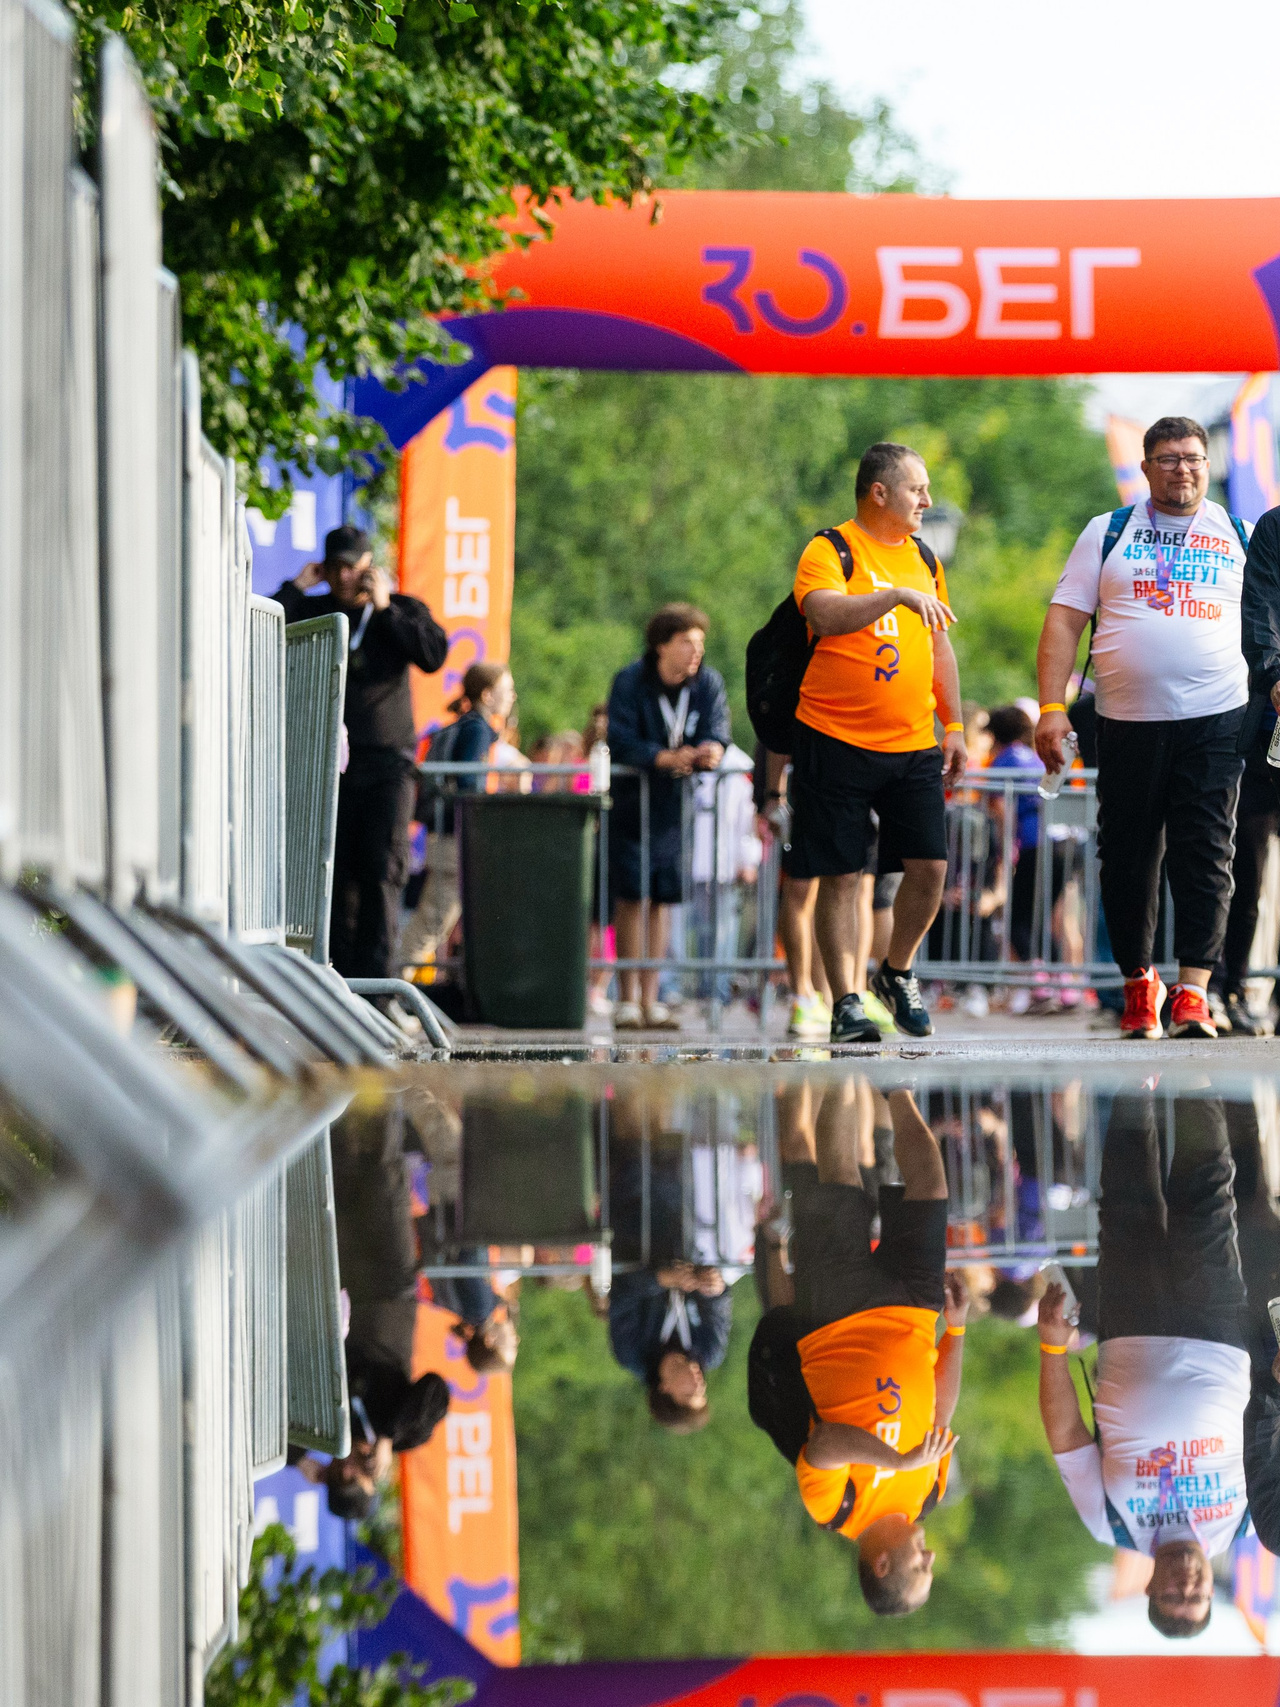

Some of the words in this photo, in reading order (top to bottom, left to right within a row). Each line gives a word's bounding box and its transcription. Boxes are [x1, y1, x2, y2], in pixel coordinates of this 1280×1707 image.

[1123, 544, 1157, 560] 45%
[1172, 564, 1220, 585] БЕГУТ
[1133, 580, 1193, 599] ВМСТЕ
